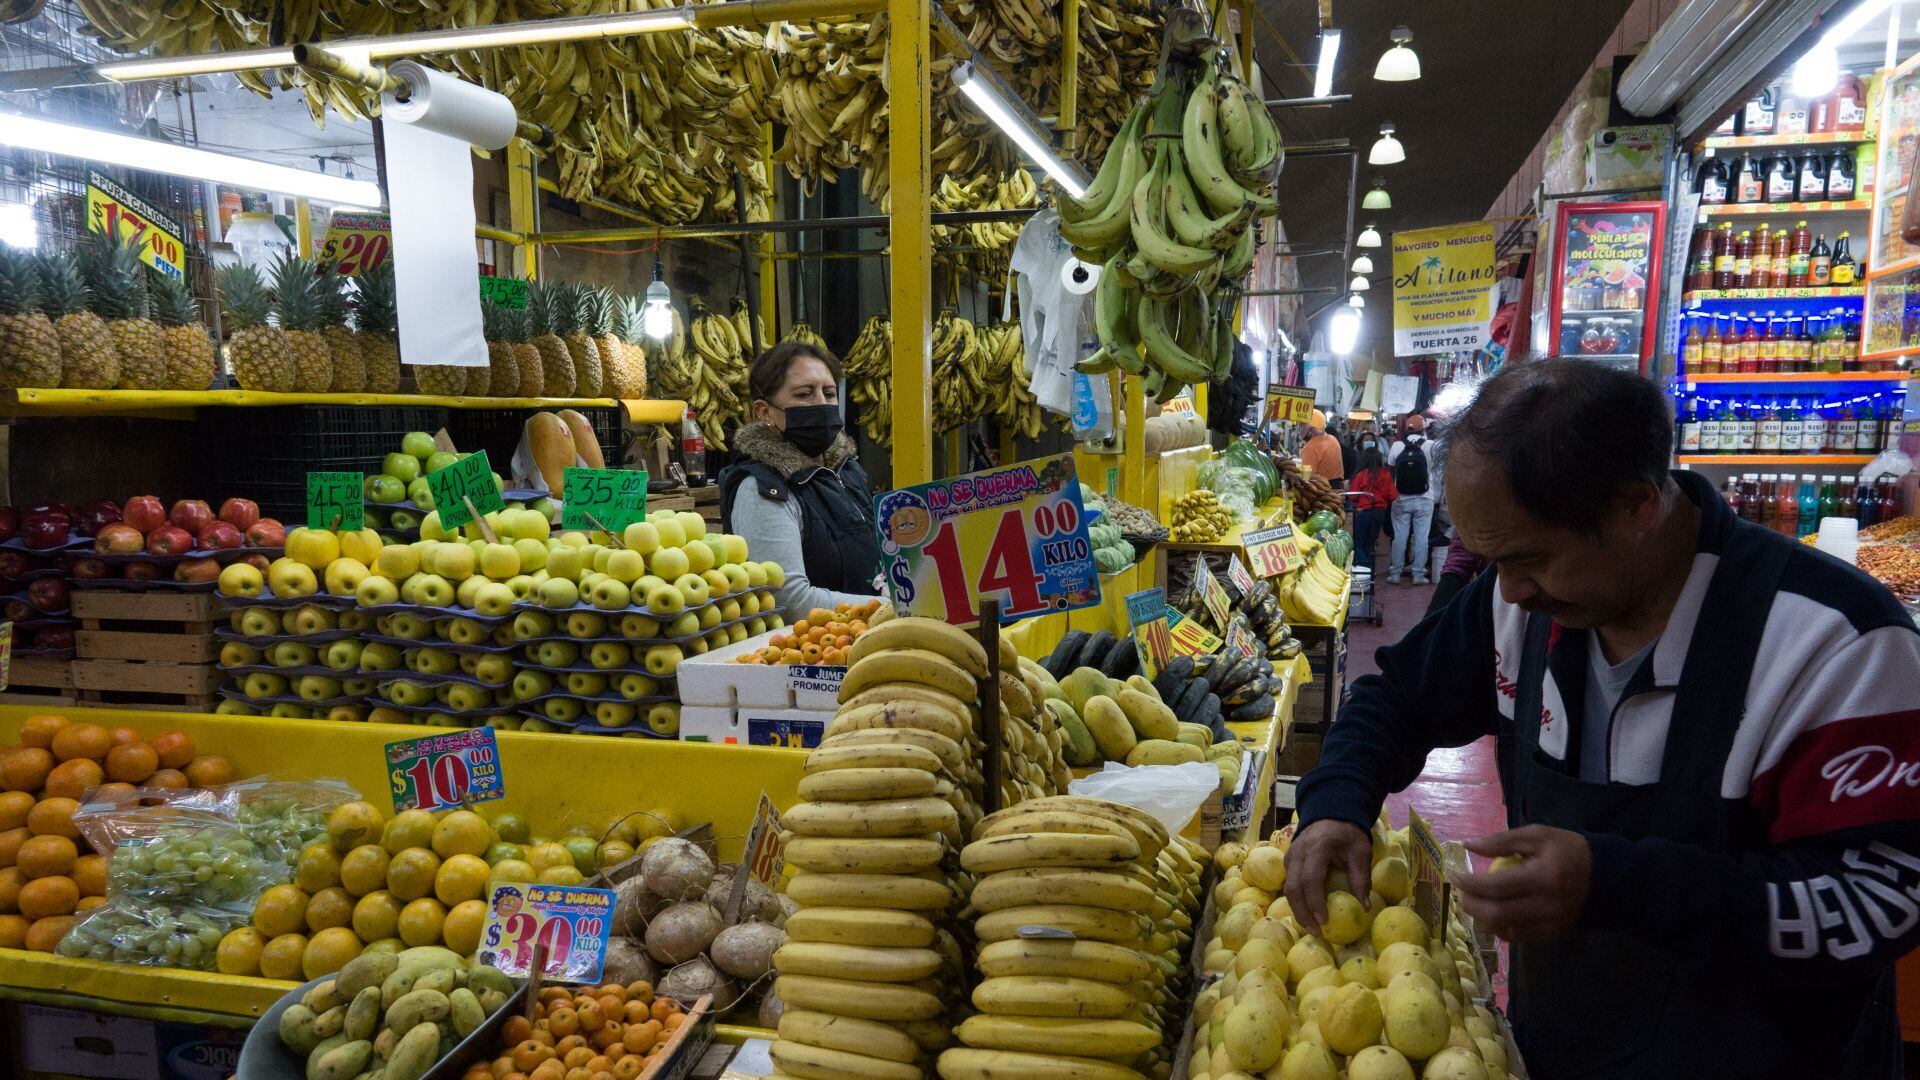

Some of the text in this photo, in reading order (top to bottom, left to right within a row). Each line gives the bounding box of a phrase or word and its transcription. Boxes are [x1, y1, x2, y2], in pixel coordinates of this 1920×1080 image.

[99, 178, 174, 233] PURA CALIDAD
[152, 232, 177, 263] 00
[337, 233, 389, 275] 20
[1394, 234, 1493, 253] MAYOREO MENUDEO
[1410, 299, 1444, 307] PRODUCTOS
[1413, 314, 1420, 322] Y
[1421, 310, 1456, 321] MUCHO
[1410, 330, 1440, 338] SERVICIO
[1446, 325, 1480, 334] DOMICILIO
[1412, 335, 1478, 349] PUERTA 26
[1174, 400, 1190, 412] 00
[1271, 396, 1310, 420] 11 00
[465, 457, 480, 477] 00
[568, 468, 598, 476] SOLO
[468, 479, 495, 502] KILO
[574, 476, 613, 506] 35
[621, 477, 640, 491] 00
[927, 467, 1039, 509] NO SE DUERMA
[313, 485, 344, 527] 45
[345, 484, 360, 500] 00
[613, 497, 645, 510] KILO
[960, 503, 974, 513] en
[890, 499, 1079, 625] $ 14 00
[1042, 539, 1088, 567] KILO
[1258, 543, 1287, 576] 18
[1282, 542, 1297, 558] 00
[391, 747, 493, 810] $ 10 00
[472, 764, 495, 777] KILO
[527, 887, 610, 906] NO SE DUERMA
[485, 913, 602, 973] $ 30 00
[575, 937, 601, 951] KILO
